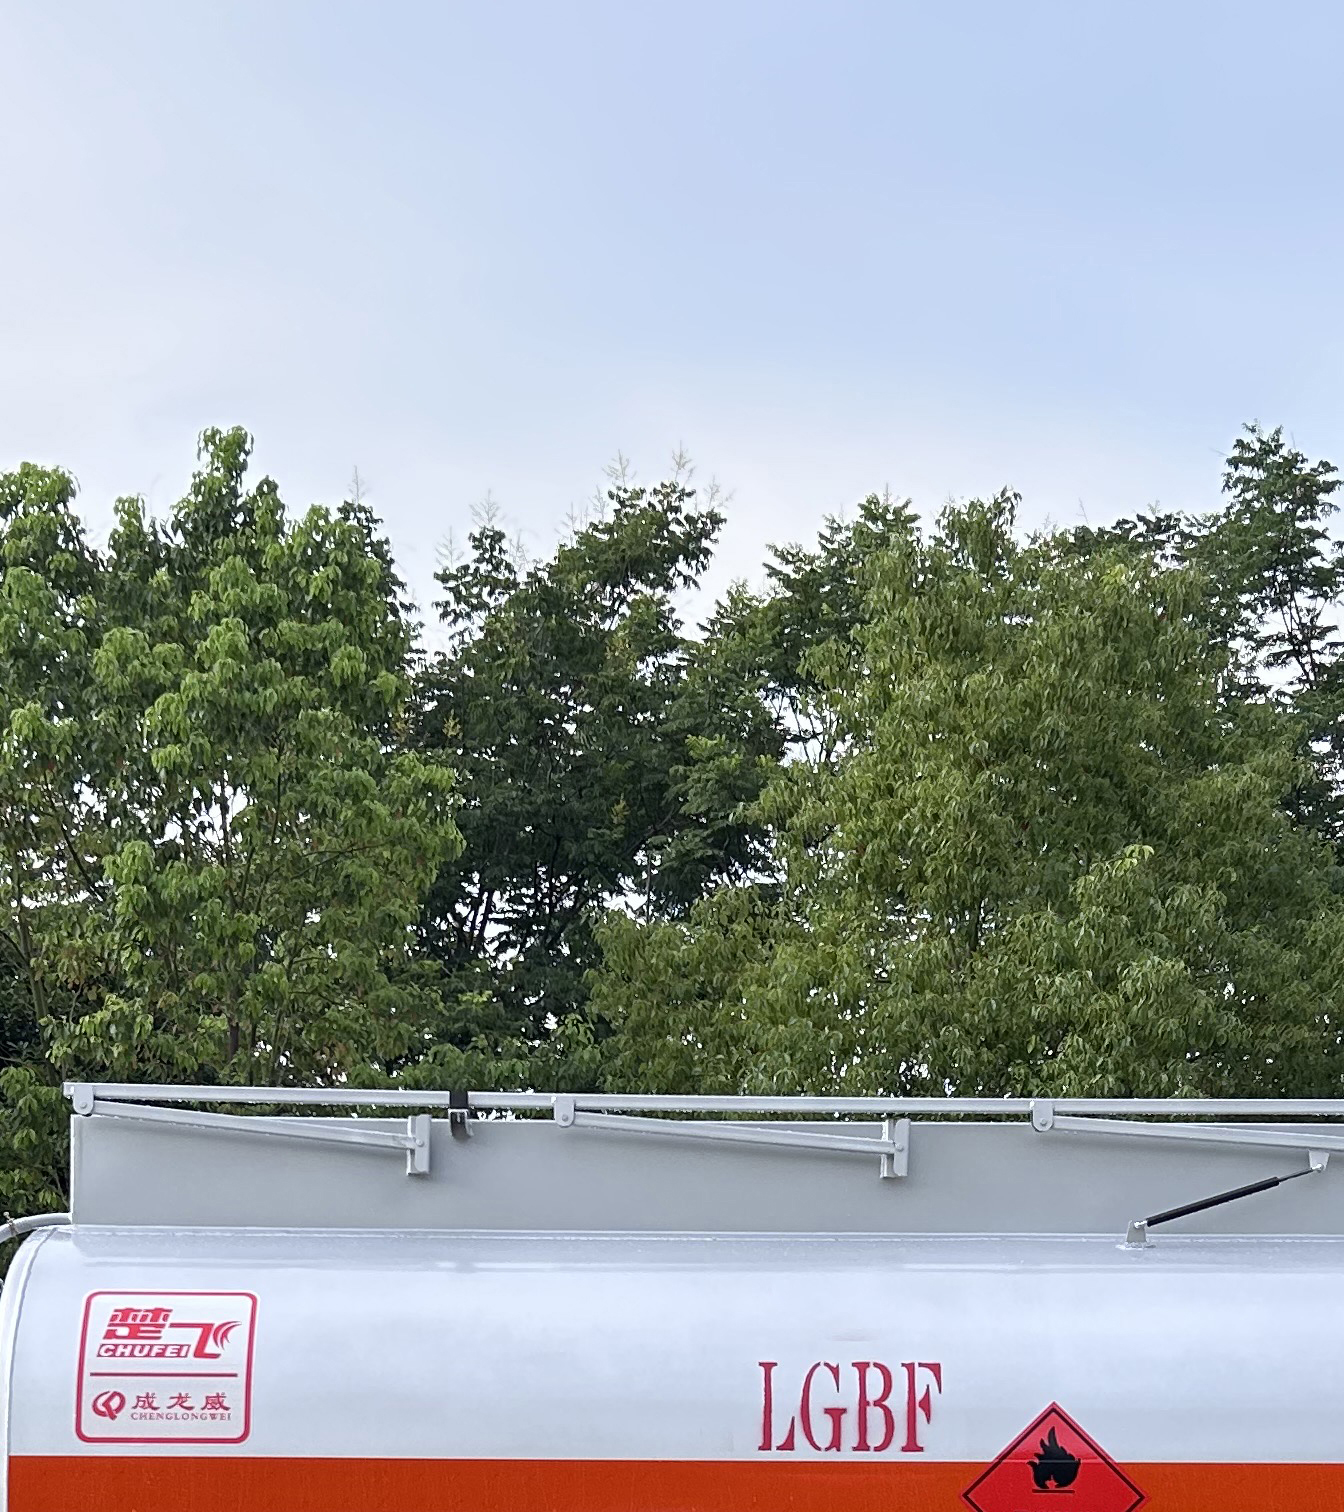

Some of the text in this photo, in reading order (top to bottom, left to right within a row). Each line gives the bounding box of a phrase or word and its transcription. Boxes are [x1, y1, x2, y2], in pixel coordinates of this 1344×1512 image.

[102, 1307, 242, 1359] 楚飞
[98, 1343, 191, 1358] CHUFEI
[131, 1391, 231, 1412] 成龙威
[757, 1360, 943, 1453] LGBF
[130, 1411, 232, 1421] CHENGLONGWEI
